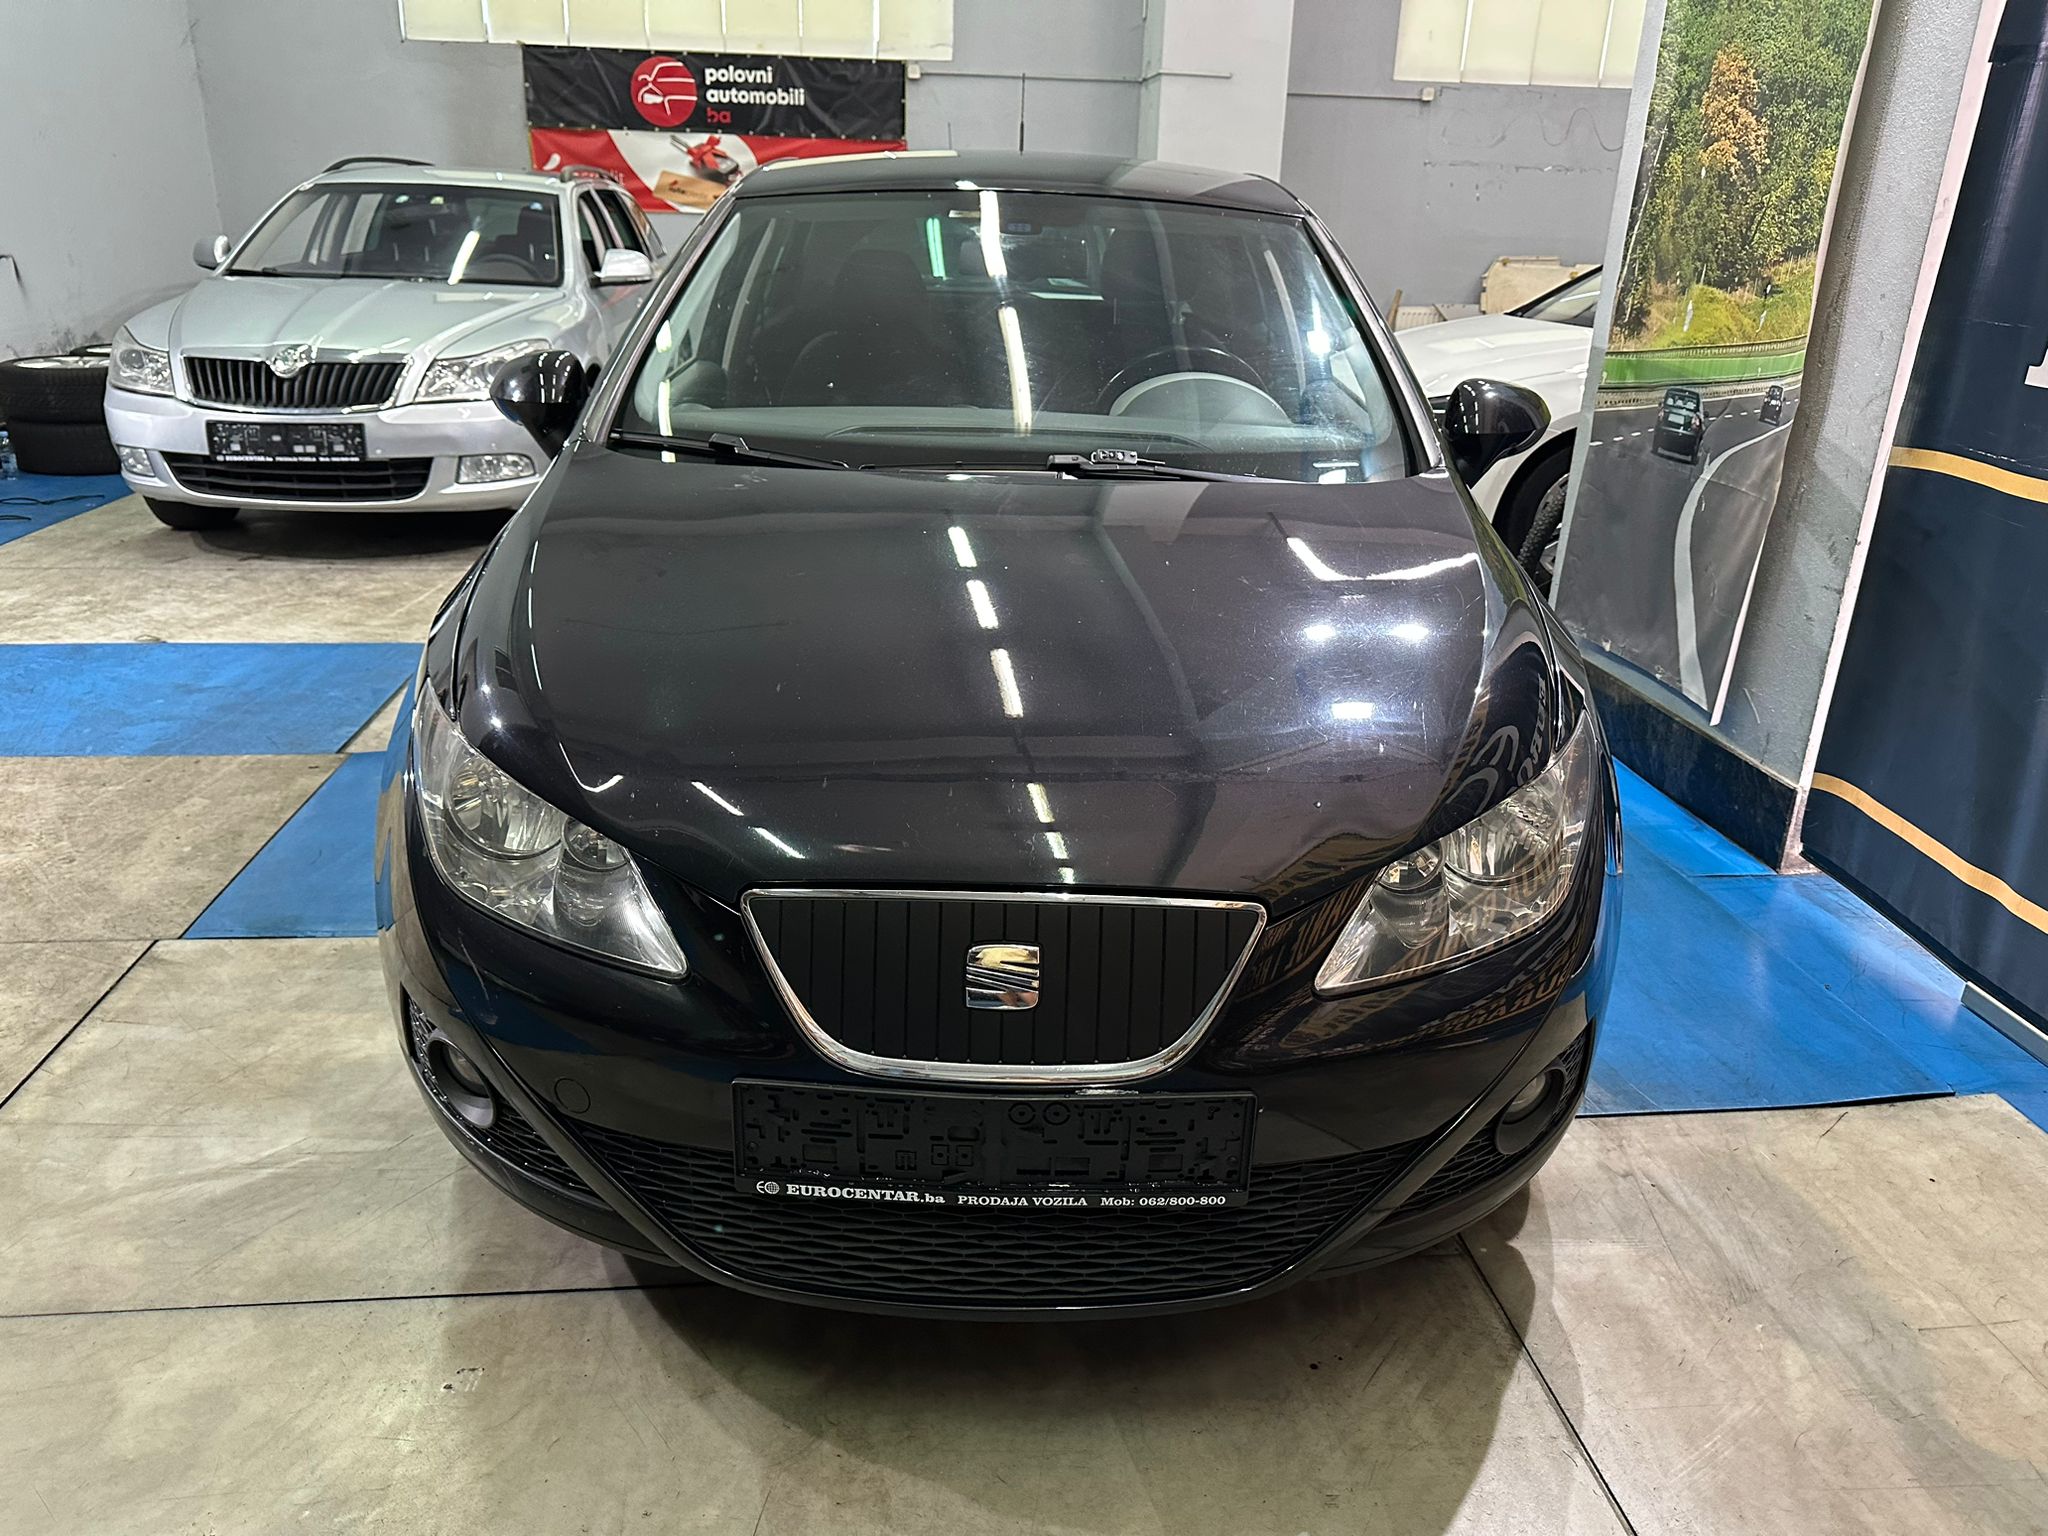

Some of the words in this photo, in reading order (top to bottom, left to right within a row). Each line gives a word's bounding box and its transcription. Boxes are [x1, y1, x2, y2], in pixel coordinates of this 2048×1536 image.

[704, 65, 773, 85] polovni
[706, 87, 805, 106] automobili
[786, 1183, 946, 1204] EUROCENTAR.ba
[957, 1195, 1029, 1207] PRODAJA
[1032, 1196, 1088, 1207] VOZILA
[1100, 1196, 1135, 1207] Mob:
[1138, 1195, 1226, 1207] 062/800-800
